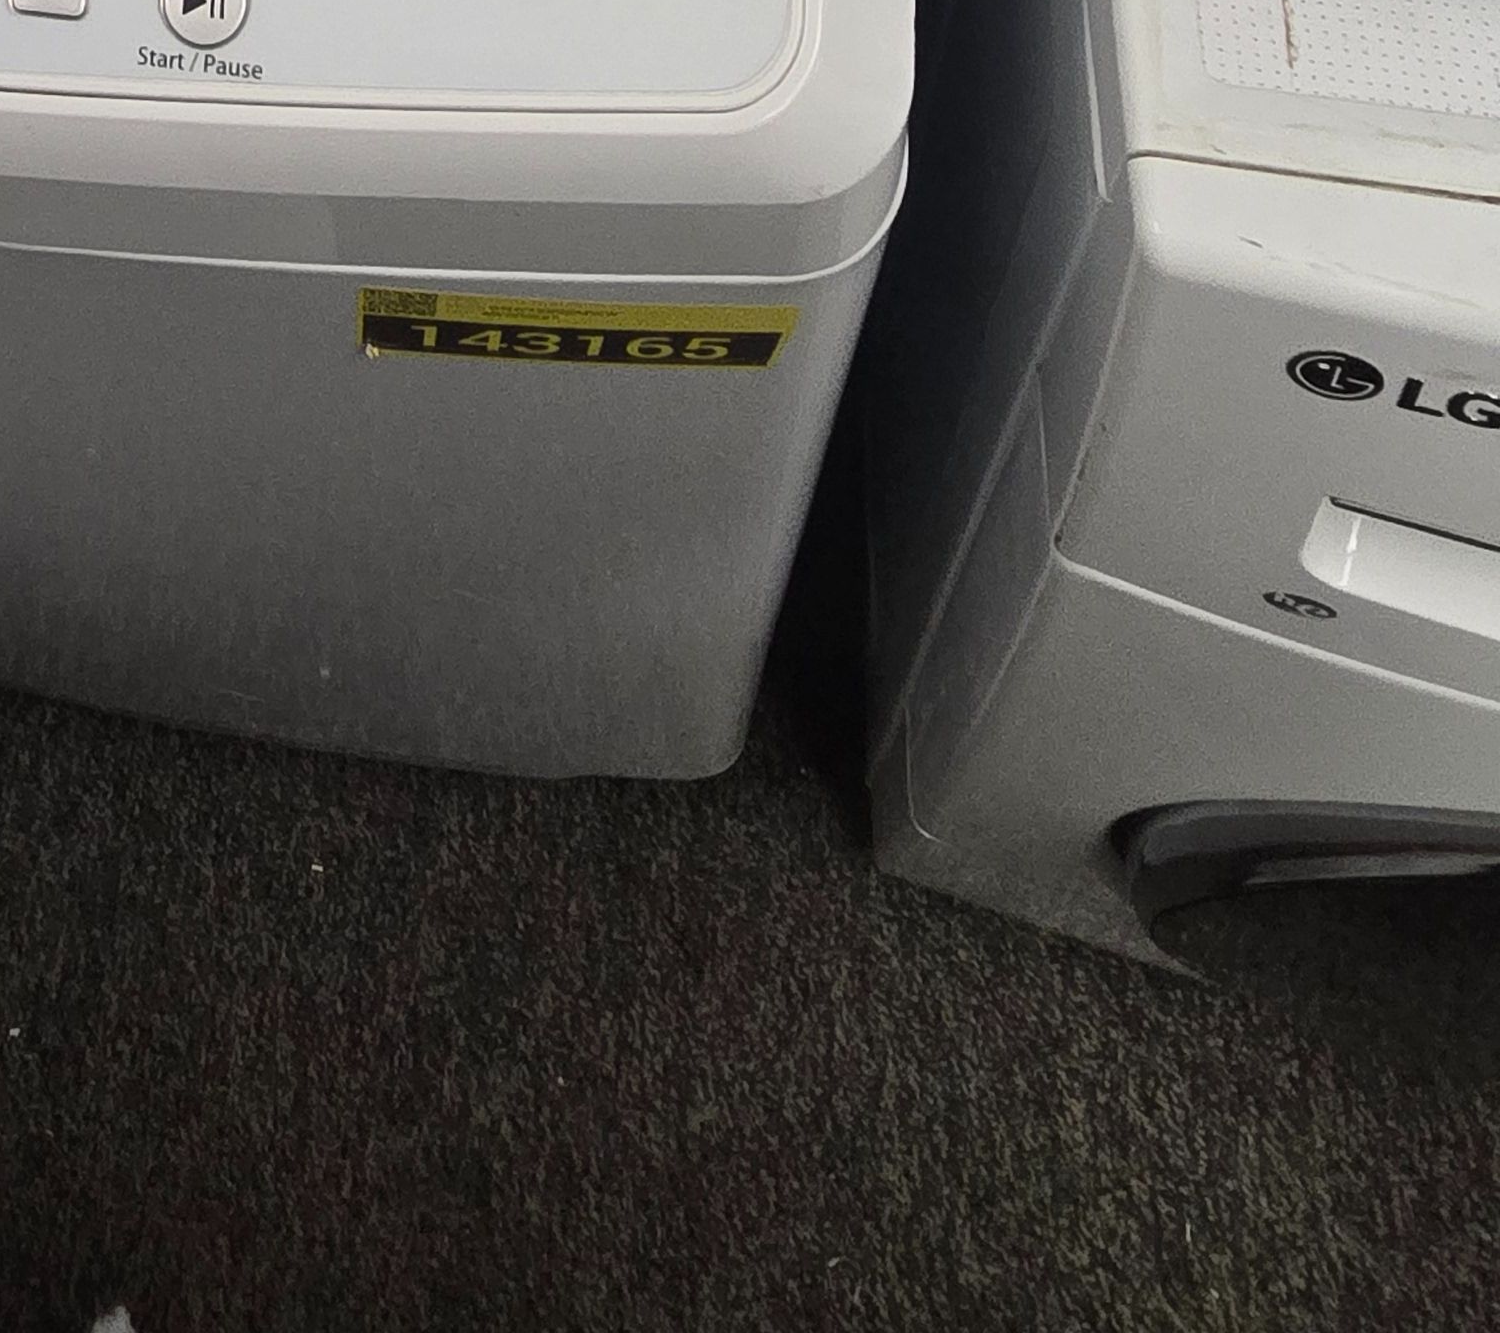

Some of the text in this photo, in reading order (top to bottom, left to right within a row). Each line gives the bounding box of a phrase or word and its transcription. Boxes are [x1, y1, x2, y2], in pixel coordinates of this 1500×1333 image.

[137, 46, 185, 72] Start
[202, 53, 263, 80] Pause
[411, 325, 732, 360] 143165
[1396, 376, 1500, 429] LG
